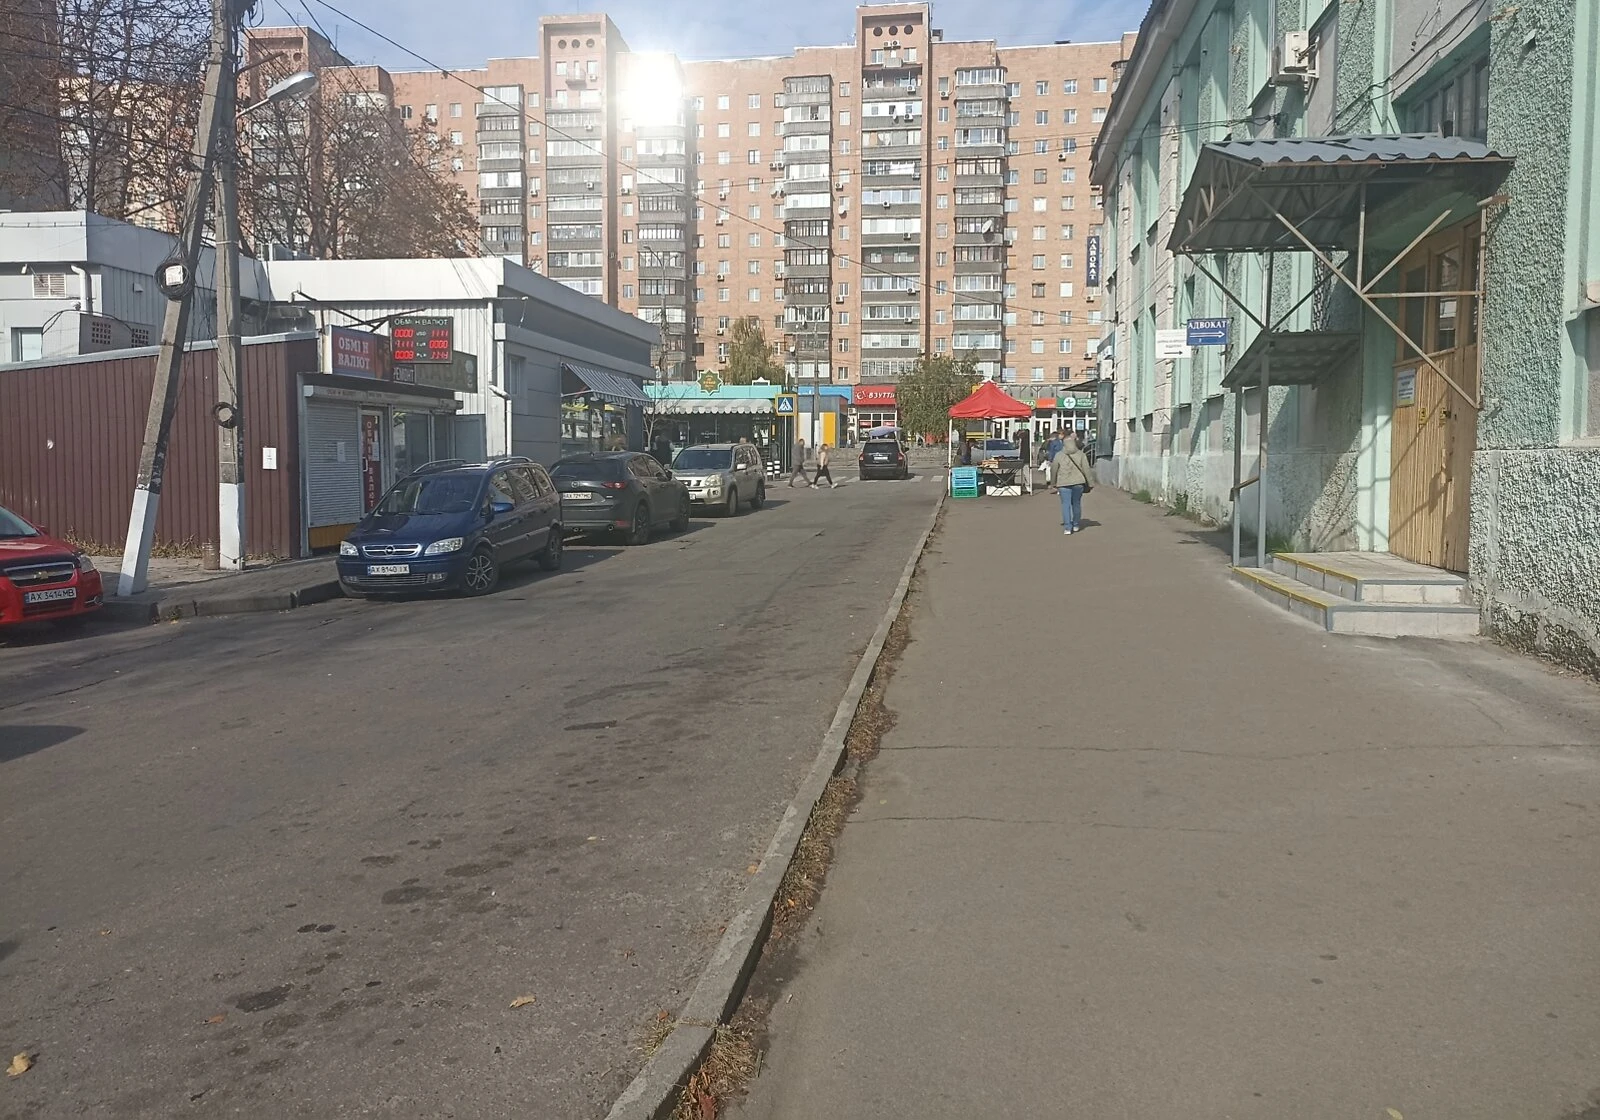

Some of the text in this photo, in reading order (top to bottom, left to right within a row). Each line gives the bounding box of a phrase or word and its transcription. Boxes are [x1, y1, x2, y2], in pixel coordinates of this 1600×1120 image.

[1088, 238, 1097, 280] АДВОКАТ
[1188, 320, 1227, 330] АДВОКАТ
[338, 337, 369, 354] ОБМІН
[338, 353, 370, 369] ВАЛЮТ
